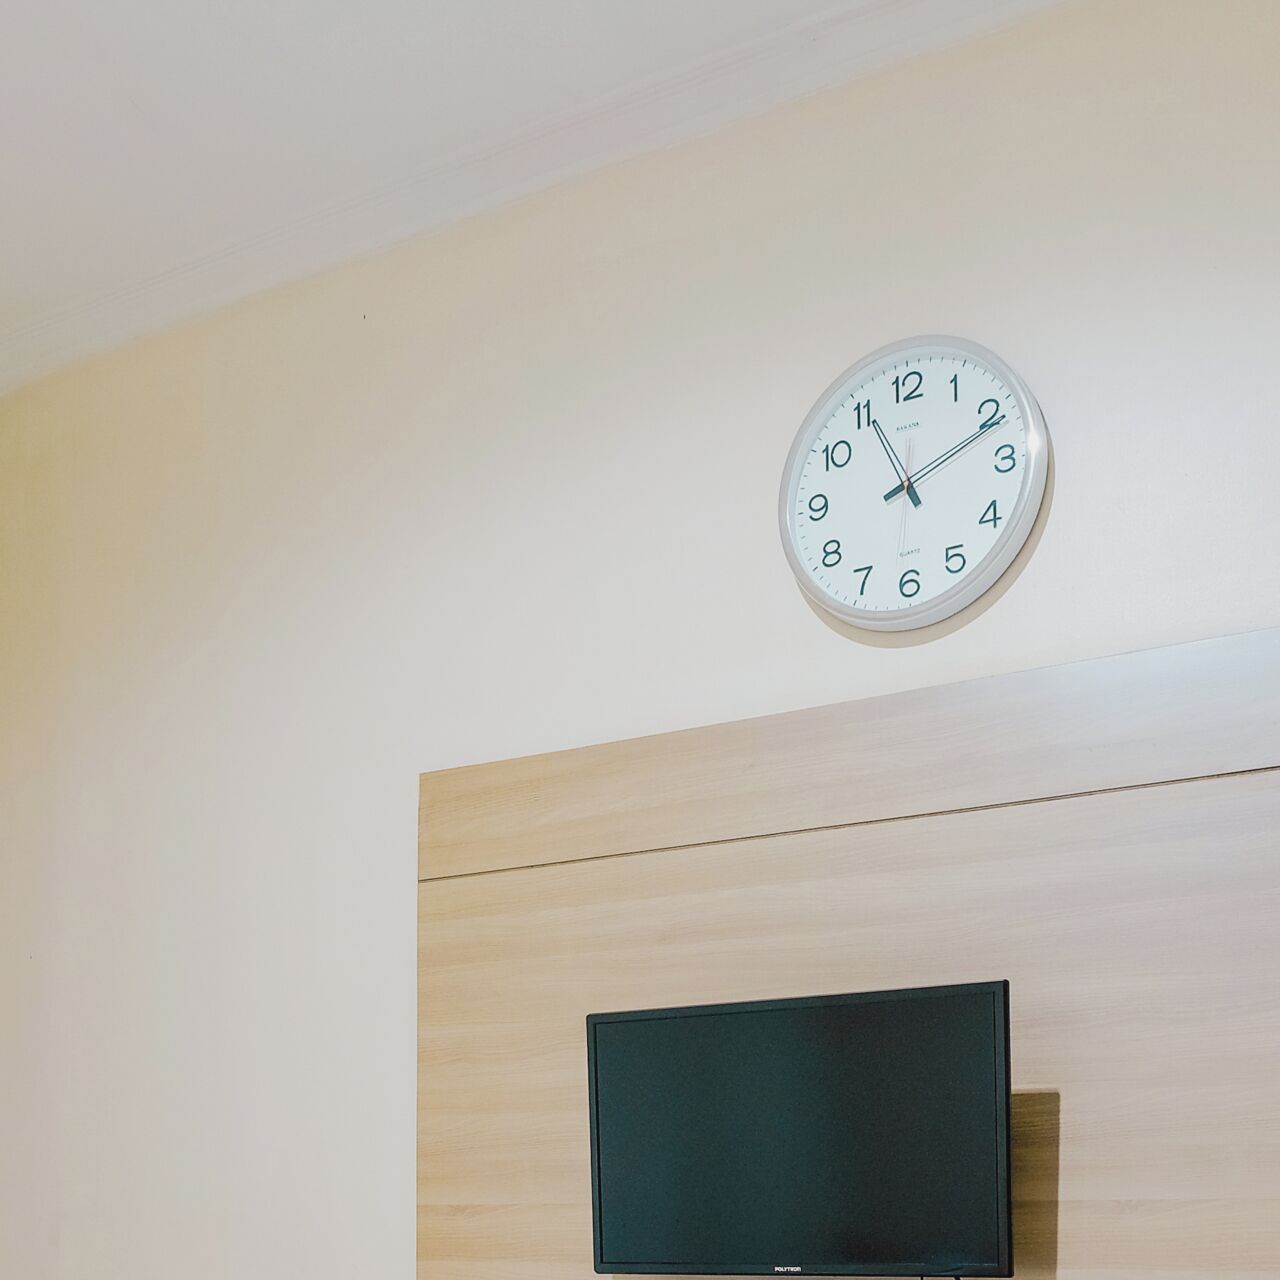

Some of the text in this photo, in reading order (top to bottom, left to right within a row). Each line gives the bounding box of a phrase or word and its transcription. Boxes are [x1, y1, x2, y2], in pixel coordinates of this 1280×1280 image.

[891, 371, 924, 404] 12
[950, 374, 957, 402] 1
[853, 399, 871, 430] 11
[977, 398, 1001, 430] 2
[822, 440, 852, 471] 10
[994, 444, 1016, 473] 3
[809, 494, 828, 521] 9
[979, 500, 1002, 528] 4
[822, 540, 842, 567] 8
[945, 544, 966, 573] 5
[853, 565, 873, 596] 7
[899, 569, 920, 597] 6
